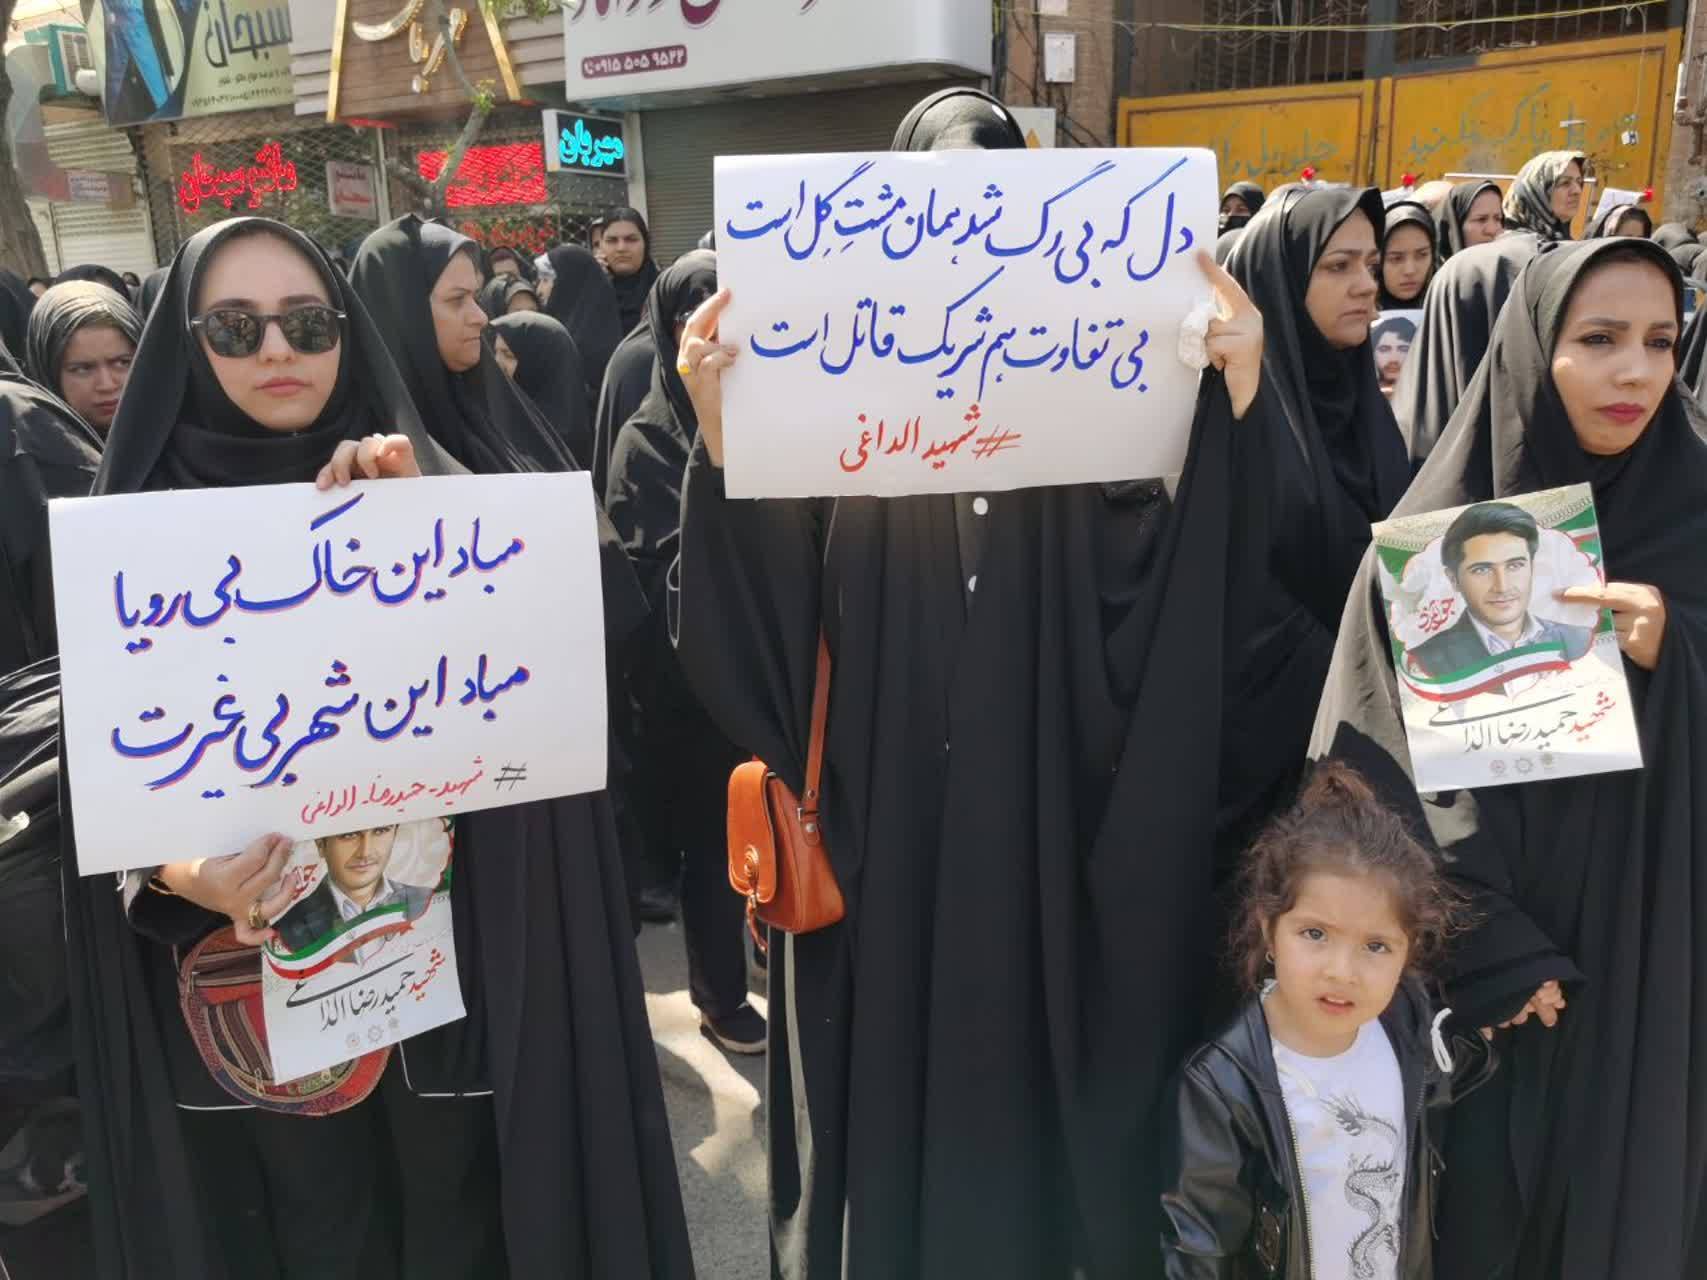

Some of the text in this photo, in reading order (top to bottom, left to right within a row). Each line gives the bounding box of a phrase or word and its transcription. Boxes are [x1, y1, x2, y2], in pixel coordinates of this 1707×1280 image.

[725, 179, 806, 241] است
[881, 187, 961, 265] همان
[951, 182, 1006, 248] شد
[1101, 156, 1193, 254] که
[1126, 190, 1195, 284] دل
[1053, 218, 1103, 289] بی
[751, 266, 1149, 402] بی تفاوت هم شریک قاتل است
[839, 414, 921, 475] الداغی
[114, 493, 526, 653] مباد این خاک بی رویا
[112, 653, 531, 800] مباد این شهر بی غیرت
[1567, 691, 1616, 743] شهید
[408, 948, 446, 1002] شهید
